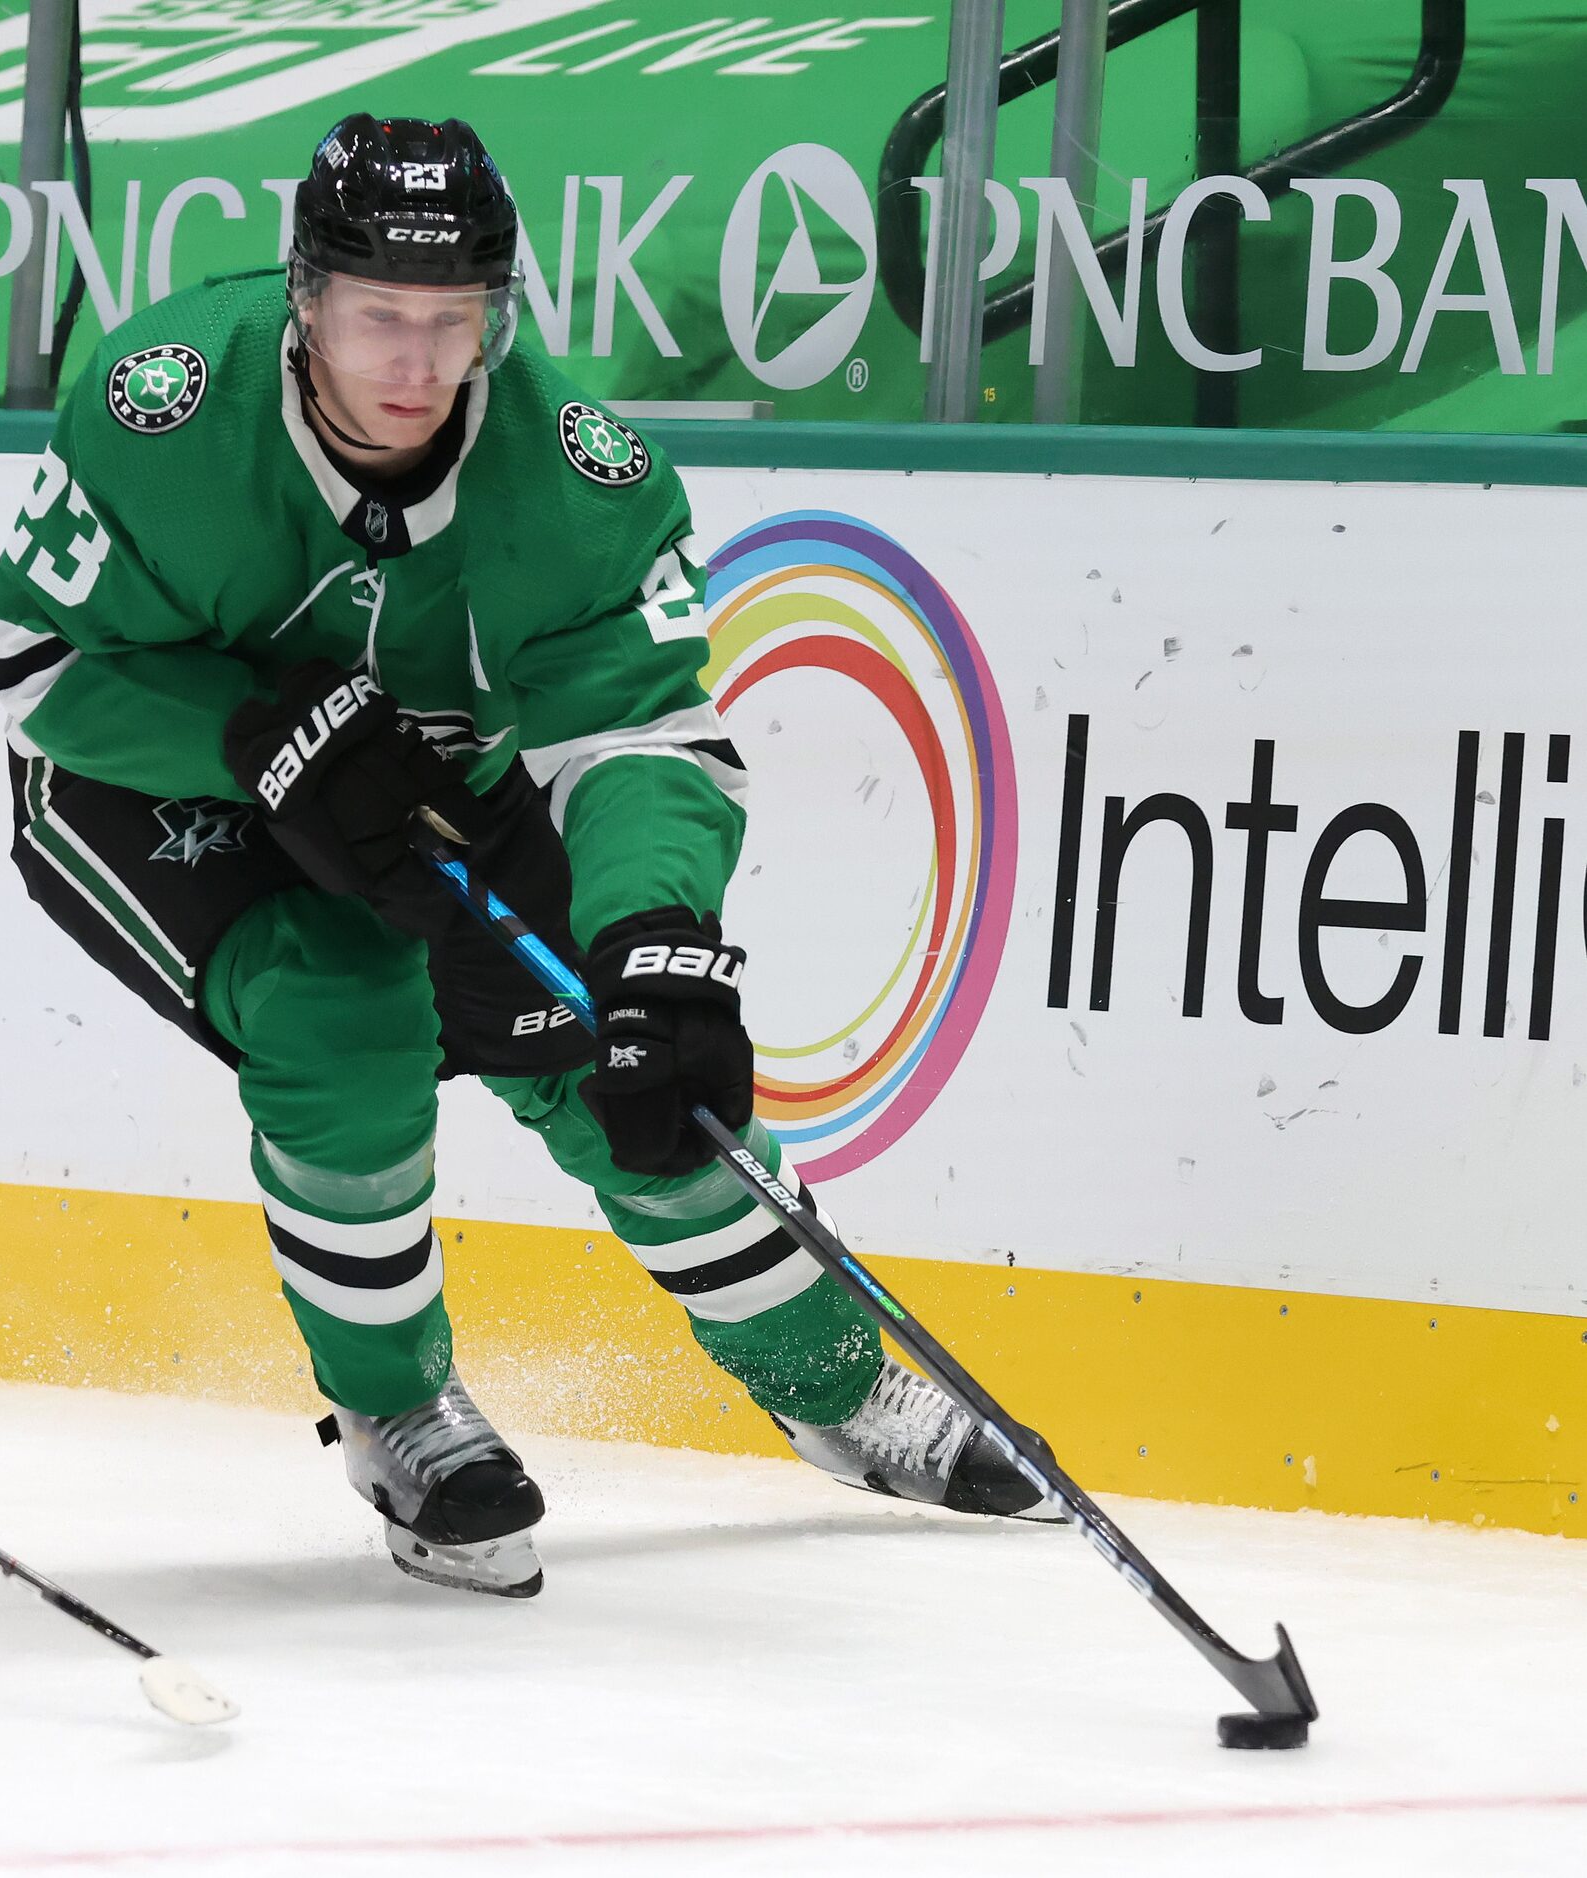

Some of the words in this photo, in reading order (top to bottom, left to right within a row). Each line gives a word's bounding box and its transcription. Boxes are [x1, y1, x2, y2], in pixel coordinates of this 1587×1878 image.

[470, 17, 935, 76] LIVE
[402, 161, 447, 190] 23
[386, 227, 461, 244] CCM
[112, 358, 147, 425] STARS
[160, 348, 201, 419] DALLAS
[983, 387, 996, 402] 15
[257, 674, 385, 812] BAUER
[1046, 713, 1587, 1041] Intelli
[608, 1008, 648, 1022] LINDELL
[729, 1148, 803, 1214] BAUER
